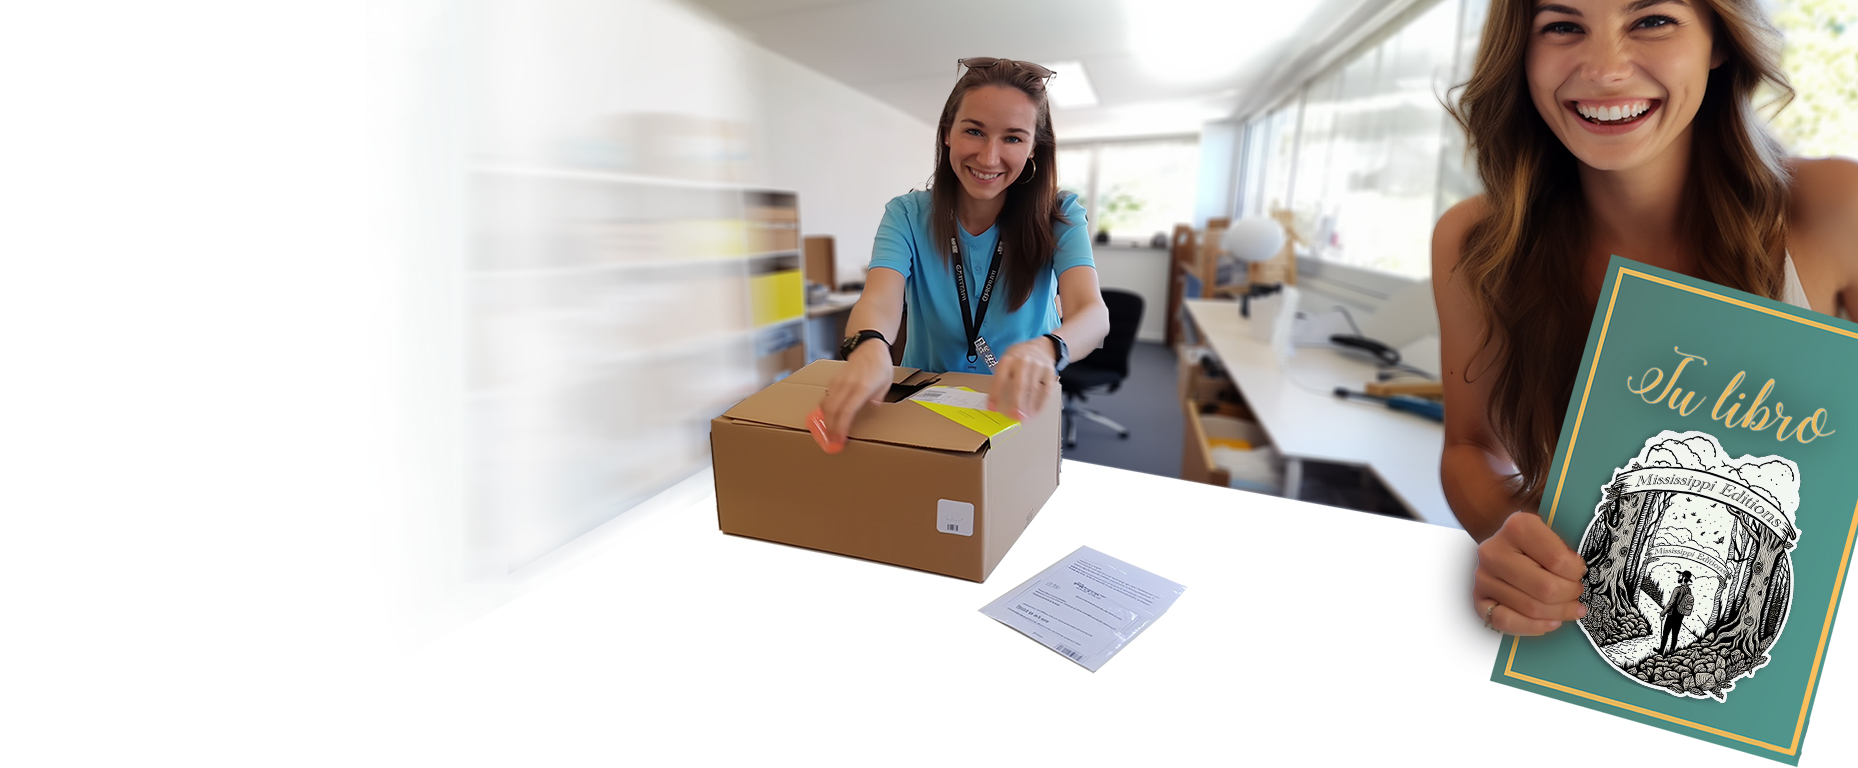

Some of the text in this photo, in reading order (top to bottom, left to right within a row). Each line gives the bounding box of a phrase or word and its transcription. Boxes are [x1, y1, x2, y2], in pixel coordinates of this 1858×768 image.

[1627, 346, 1836, 443] Tu libro
[1635, 474, 1782, 529] Mississippi Editions
[1654, 547, 1727, 575] Mississippi Editions
